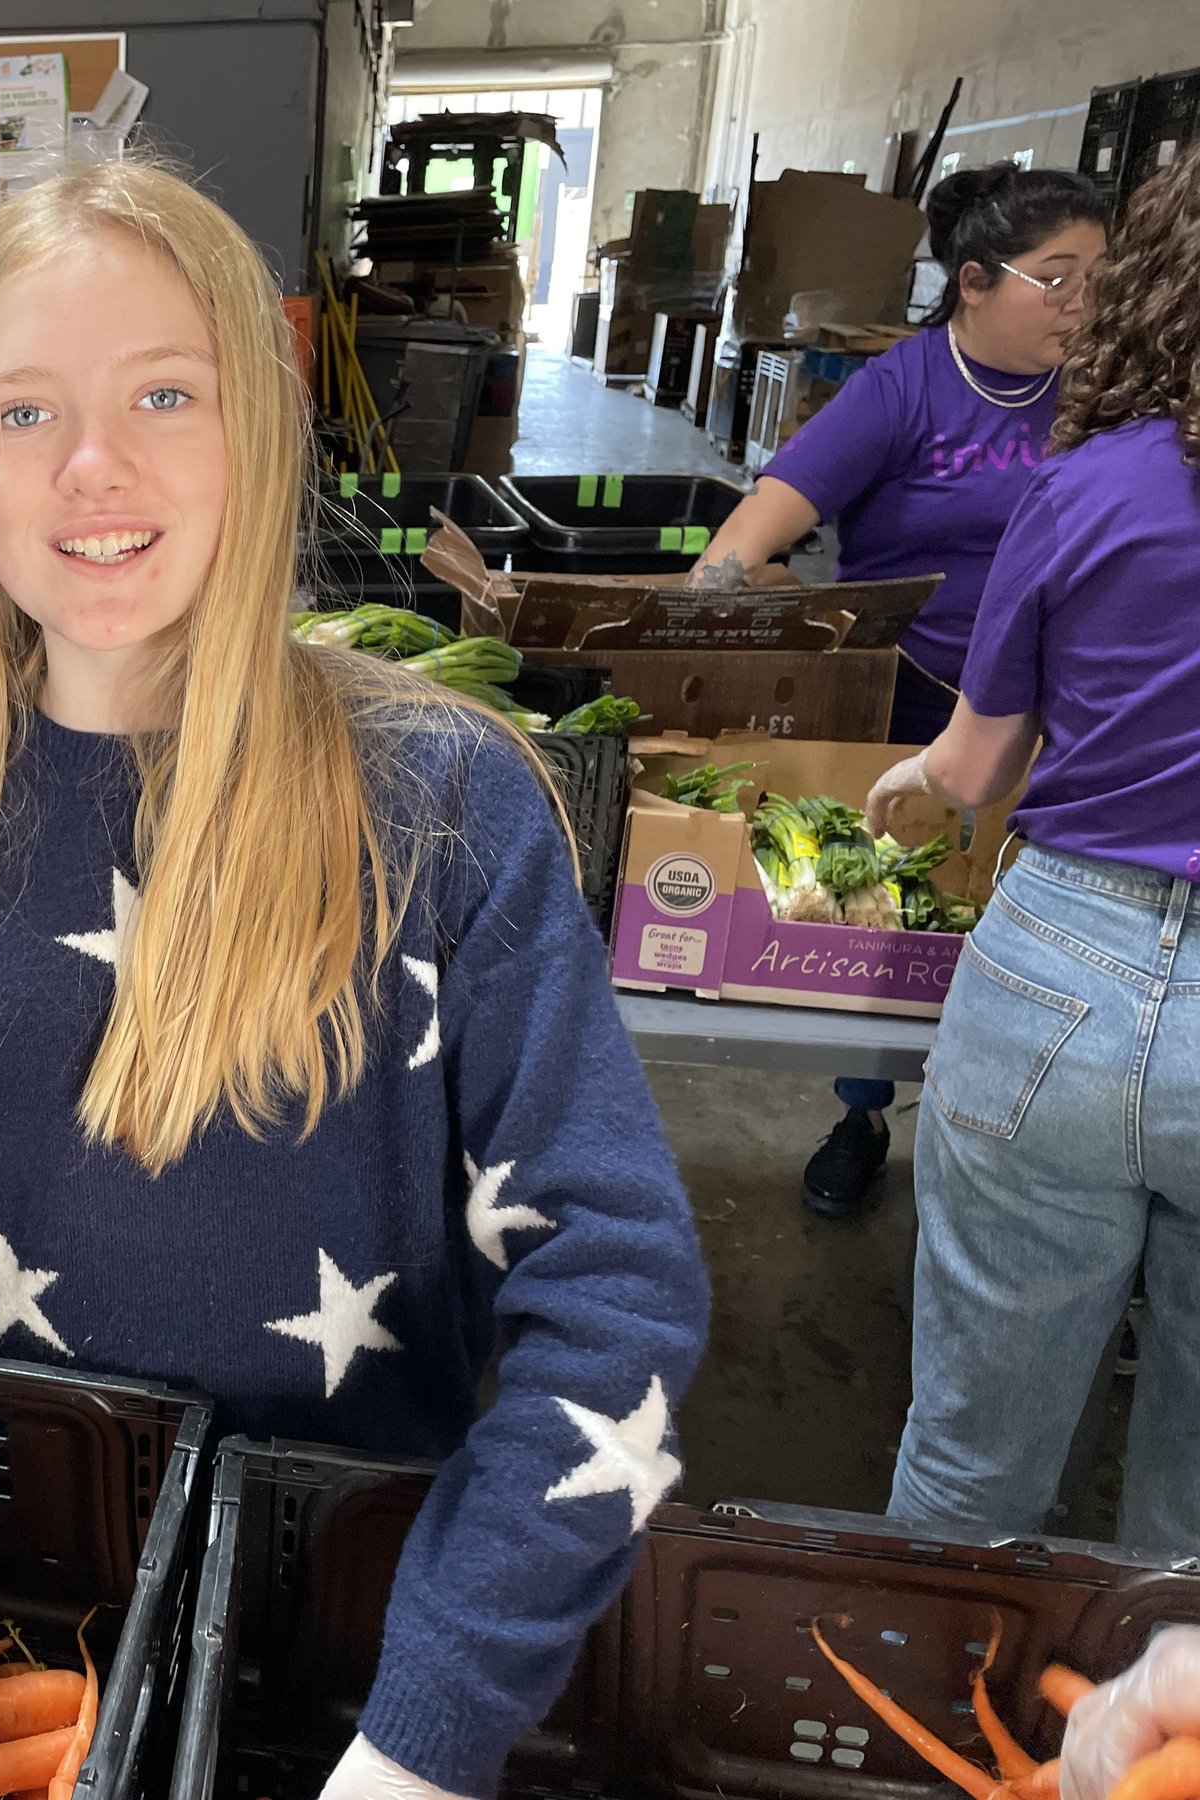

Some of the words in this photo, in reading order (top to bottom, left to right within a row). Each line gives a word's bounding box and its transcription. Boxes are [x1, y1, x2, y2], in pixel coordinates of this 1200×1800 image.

[668, 869, 700, 884] USDA
[662, 885, 702, 898] ORGANIC
[648, 927, 678, 941] Great
[848, 939, 922, 955] TANIMURA
[926, 947, 937, 957] &
[654, 951, 688, 961] wedges
[656, 961, 683, 971] wraps
[751, 939, 895, 980] Artisan
[906, 961, 956, 988] RO
